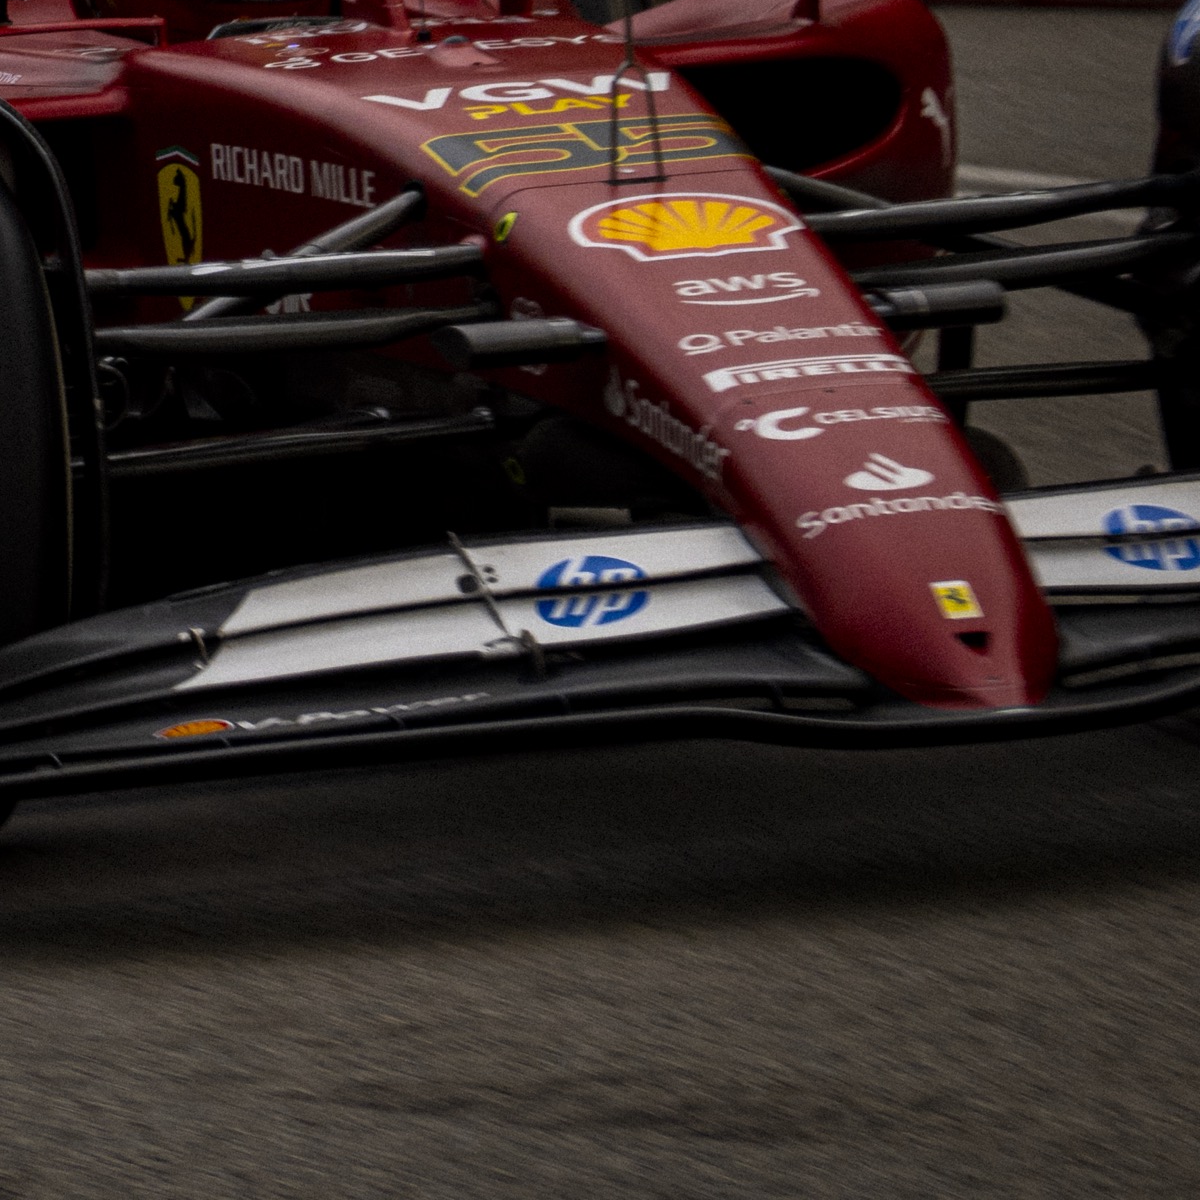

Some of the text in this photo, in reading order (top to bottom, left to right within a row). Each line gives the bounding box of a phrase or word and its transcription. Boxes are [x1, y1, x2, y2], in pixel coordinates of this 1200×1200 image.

[361, 71, 671, 110] VGW
[463, 93, 634, 120] PLAY
[209, 142, 379, 209] RICHARD MILLE
[420, 113, 758, 198] 55
[672, 272, 807, 297] aws
[545, 557, 636, 627] hp
